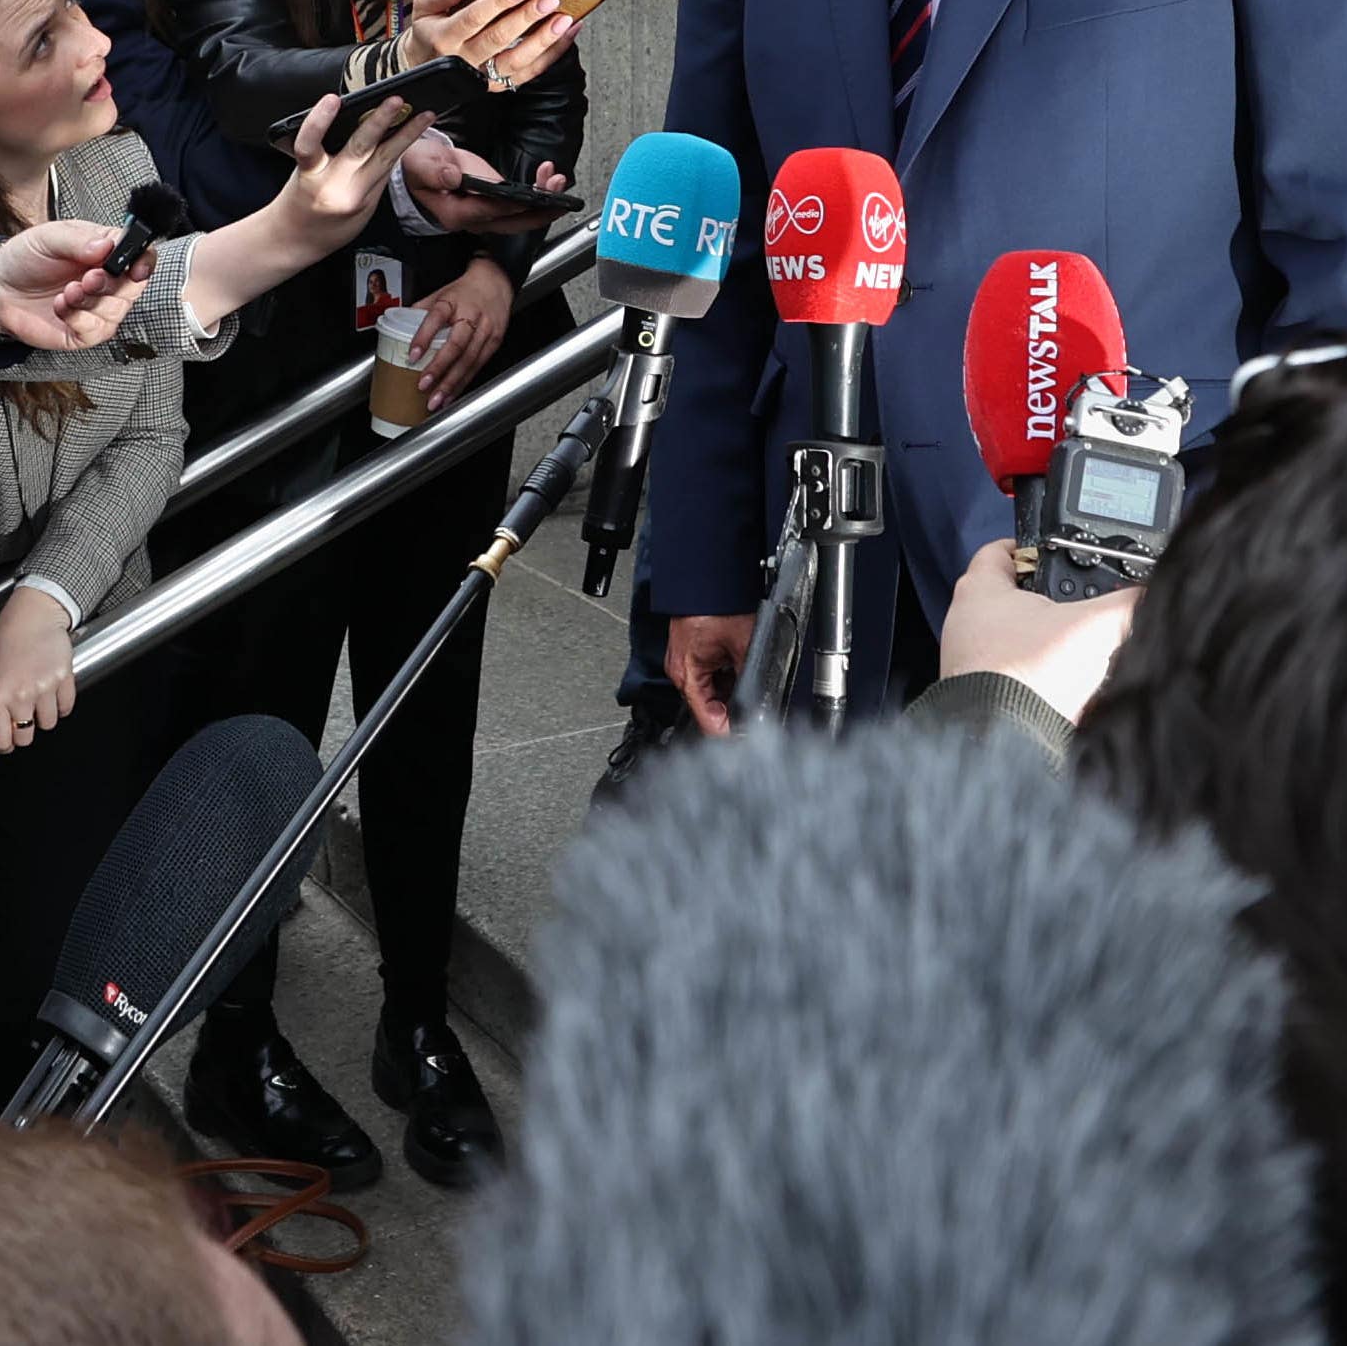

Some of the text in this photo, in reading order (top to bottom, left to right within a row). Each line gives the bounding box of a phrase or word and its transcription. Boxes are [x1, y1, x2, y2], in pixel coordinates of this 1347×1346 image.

[607, 197, 681, 246] RTÉ
[794, 209, 820, 219] media
[868, 203, 894, 243] Virgin
[1027, 262, 1058, 441] newsTALK
